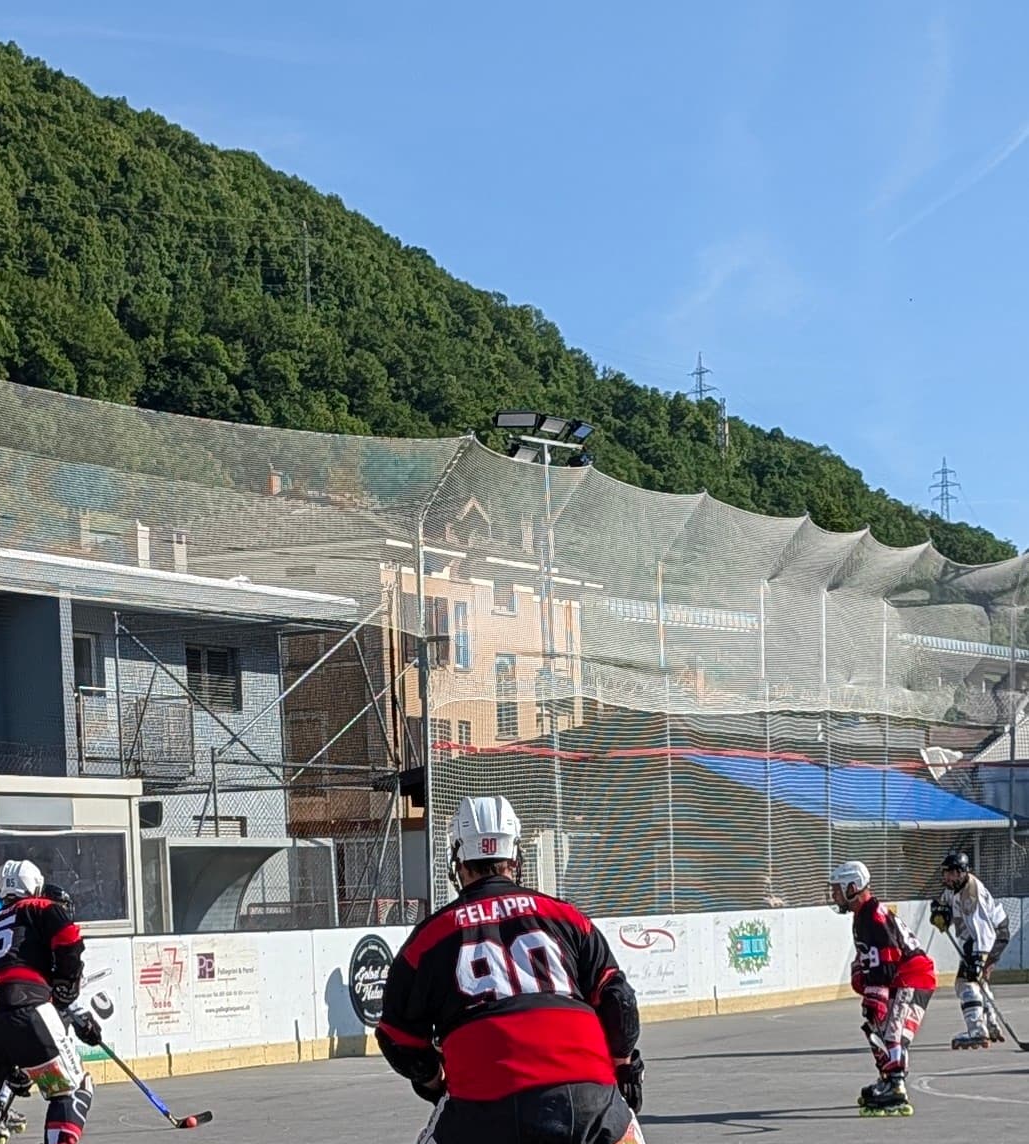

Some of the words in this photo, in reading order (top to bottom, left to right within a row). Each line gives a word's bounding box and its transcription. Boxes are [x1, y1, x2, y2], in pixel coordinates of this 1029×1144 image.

[481, 838, 498, 855] 90
[455, 895, 538, 925] FELAPPI
[455, 930, 573, 1001] 90
